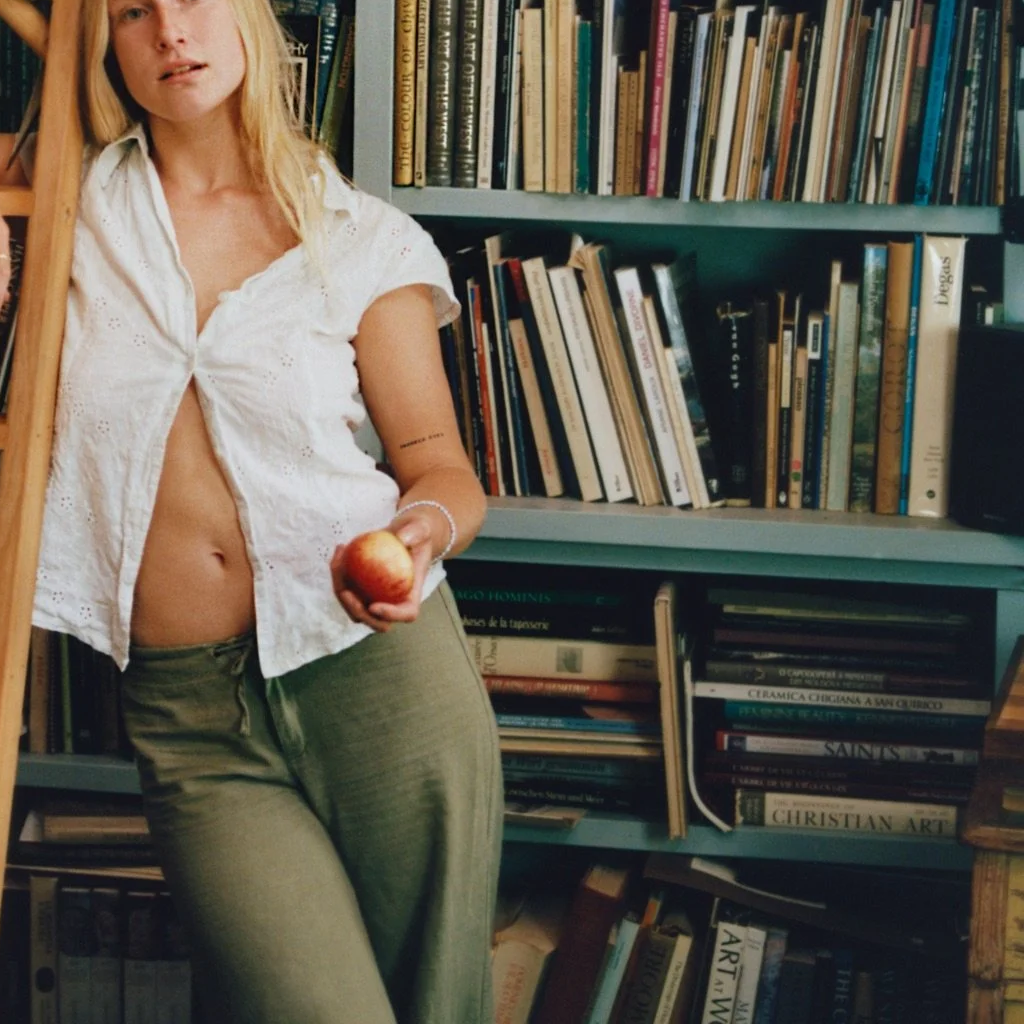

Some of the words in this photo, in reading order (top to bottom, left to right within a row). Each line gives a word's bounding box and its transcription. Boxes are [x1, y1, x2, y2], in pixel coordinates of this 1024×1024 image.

[401, 44, 413, 64] OF
[418, 27, 426, 70] CHIVALRY
[438, 28, 451, 58] ART
[463, 30, 477, 61] ART
[437, 60, 450, 77] OF
[462, 63, 475, 81] OF
[436, 77, 450, 106] THE
[461, 81, 474, 109] THE
[435, 106, 449, 149] WEST
[459, 109, 473, 151] WEST
[933, 255, 953, 307] Degas
[637, 335, 652, 369] DANIEL
[729, 353, 742, 390] Gogh
[883, 318, 906, 433] COROT
[488, 590, 552, 605] HOMINIS
[747, 688, 806, 702] CERAMICA
[808, 691, 862, 705] CHIGIANA
[873, 697, 894, 708] SAN
[824, 740, 901, 763] SAINTS
[772, 807, 893, 832] CHRISTIAN
[907, 816, 950, 836] ART
[716, 927, 744, 982] ART
[712, 978, 726, 993] AT
